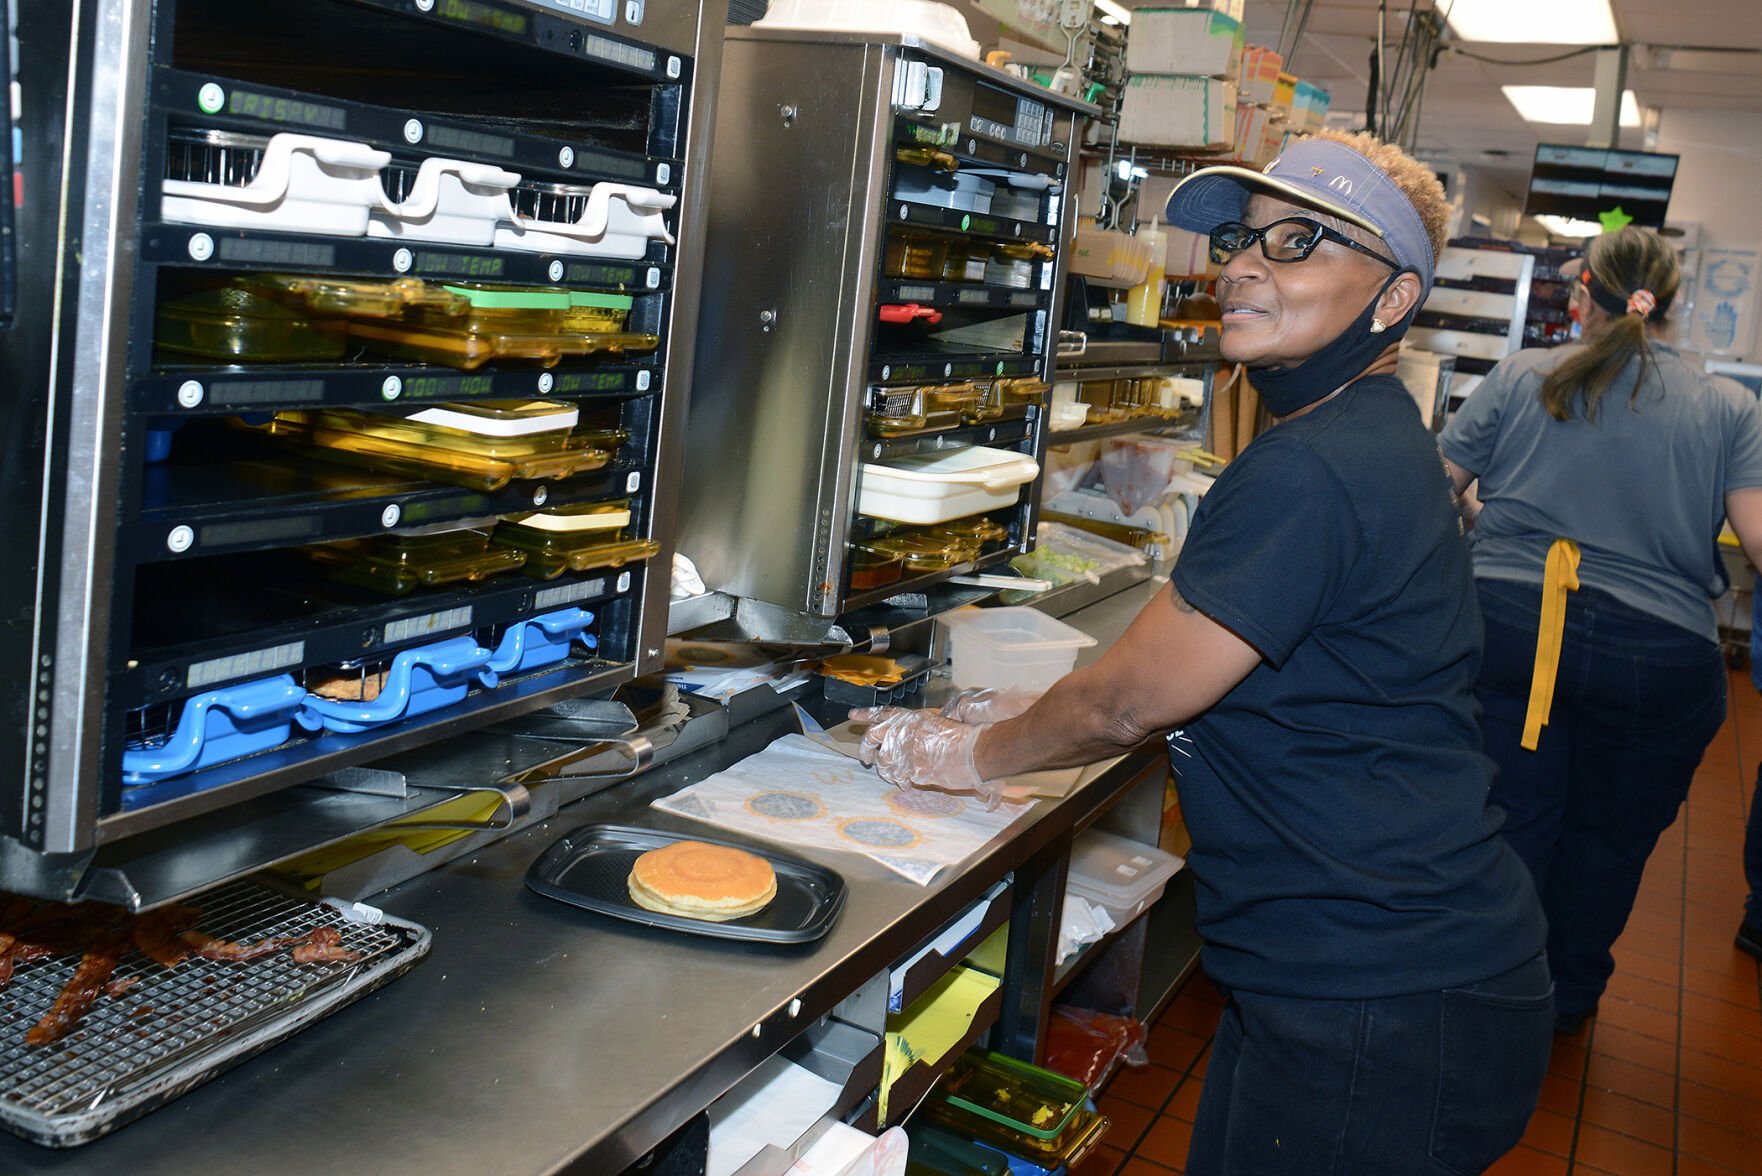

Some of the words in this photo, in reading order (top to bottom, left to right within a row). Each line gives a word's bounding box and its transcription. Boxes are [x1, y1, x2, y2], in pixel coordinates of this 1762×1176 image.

[229, 90, 320, 122] CRISPY
[462, 255, 503, 276] TEMP
[459, 376, 495, 396] NOW
[591, 372, 625, 391] TEMP
